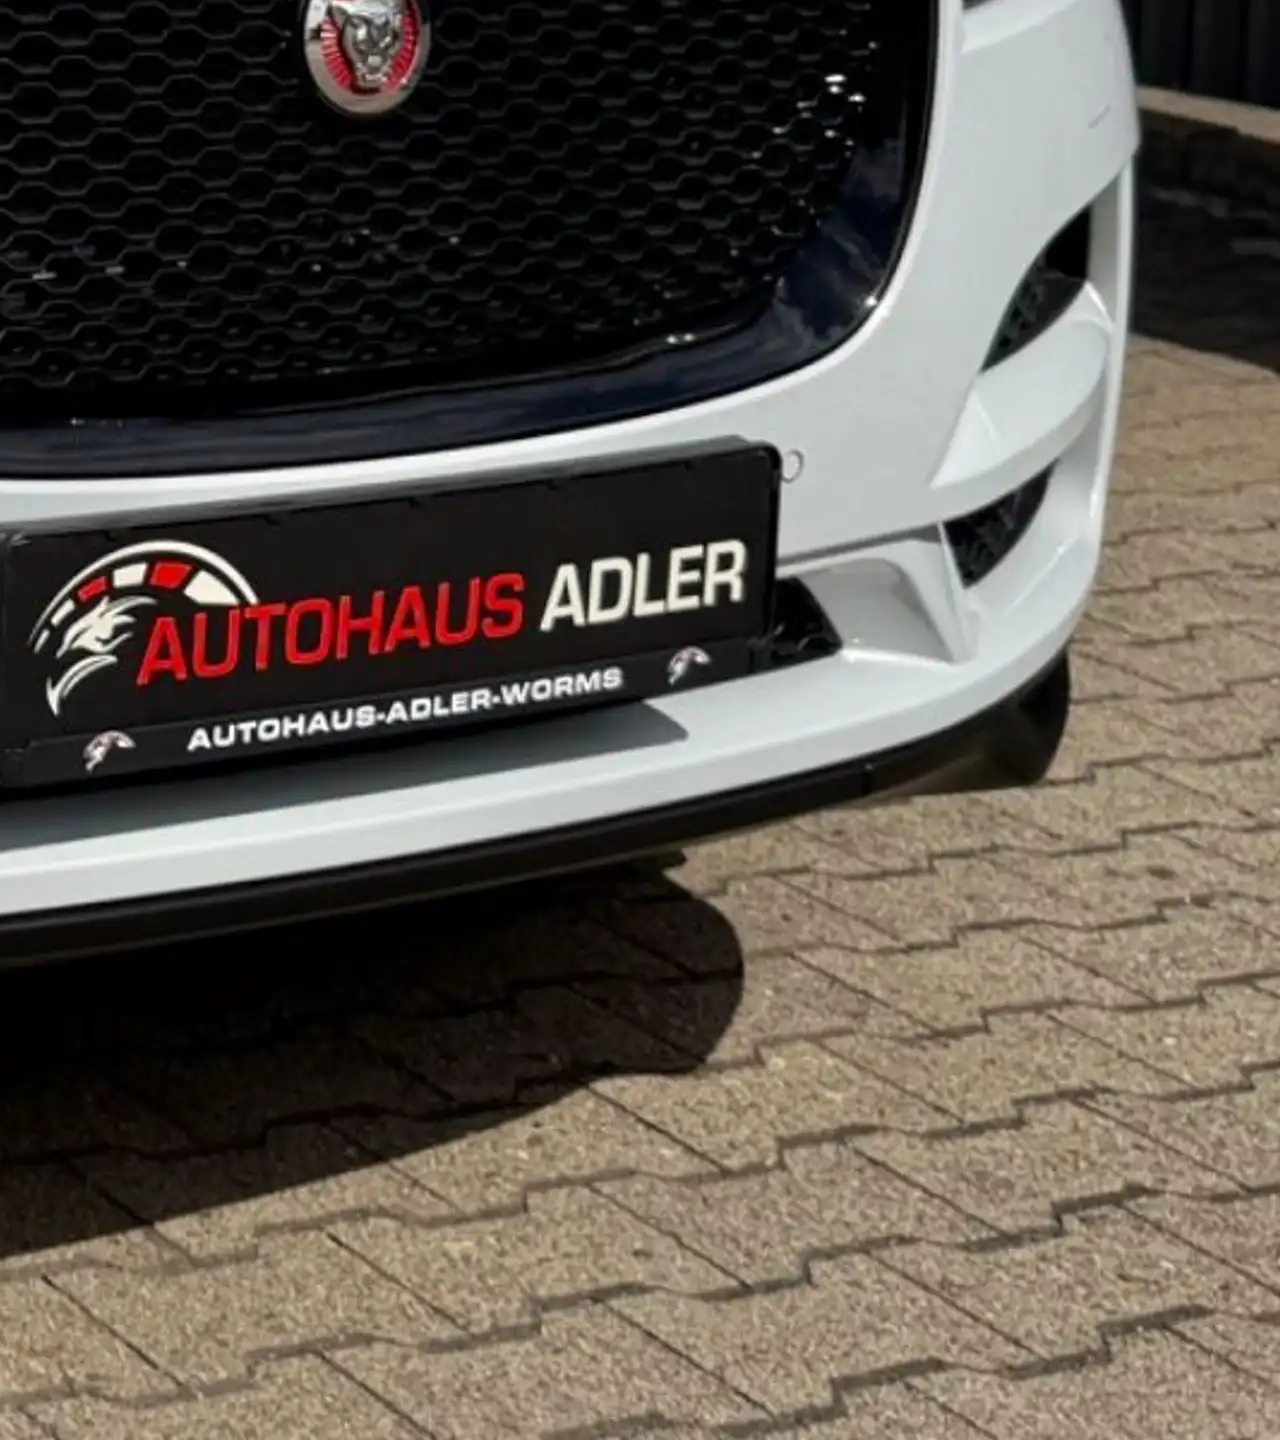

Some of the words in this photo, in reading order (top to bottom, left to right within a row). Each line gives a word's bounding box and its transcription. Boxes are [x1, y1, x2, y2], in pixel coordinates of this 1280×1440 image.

[137, 572, 526, 686] AUTOHAUS
[540, 539, 747, 632] ADLER
[187, 667, 624, 751] AUTOHAUS-ADLER-WORMS
